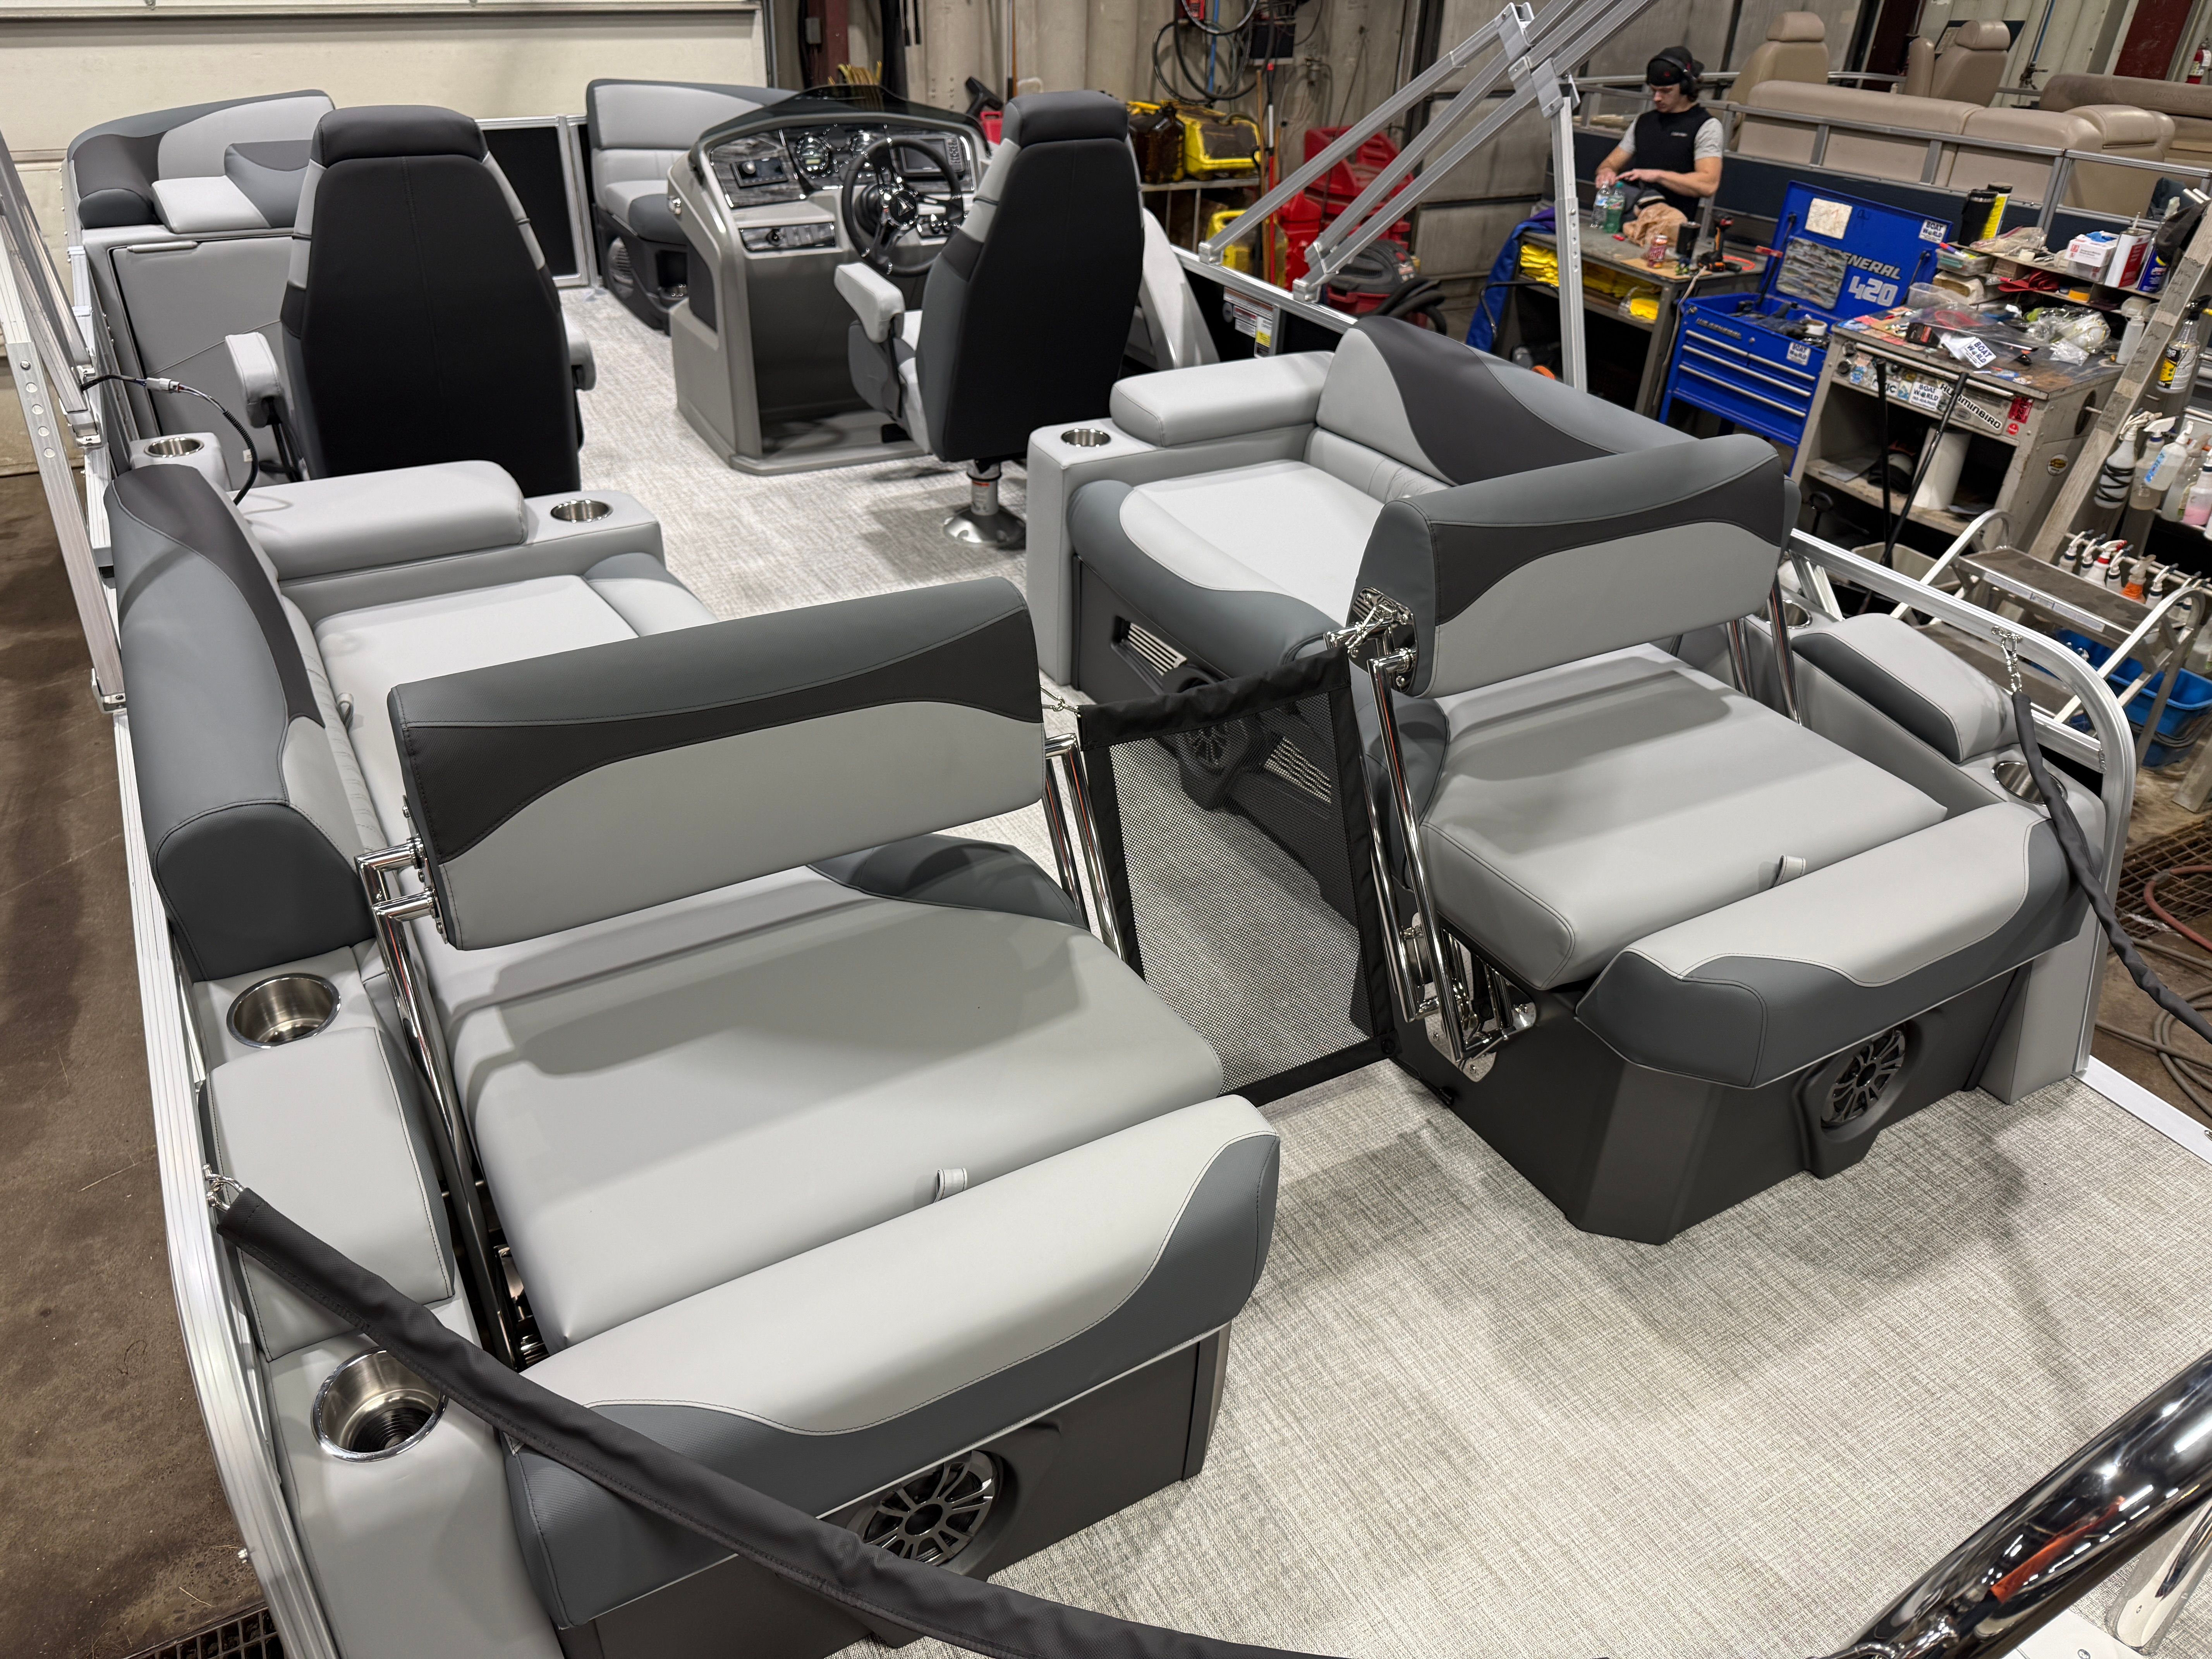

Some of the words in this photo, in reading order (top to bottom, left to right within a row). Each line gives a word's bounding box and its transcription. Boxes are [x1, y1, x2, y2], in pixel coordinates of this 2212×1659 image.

[1926, 221, 1943, 231] BOAT
[1841, 252, 1901, 280] ENERAL
[1848, 275, 1898, 306] 420
[1792, 343, 1807, 353] BOAT
[1967, 344, 1986, 363] WORLD
[1974, 342, 1992, 357] BOAT
[1914, 388, 1939, 400] WORLD
[1919, 384, 1937, 393] BOAT
